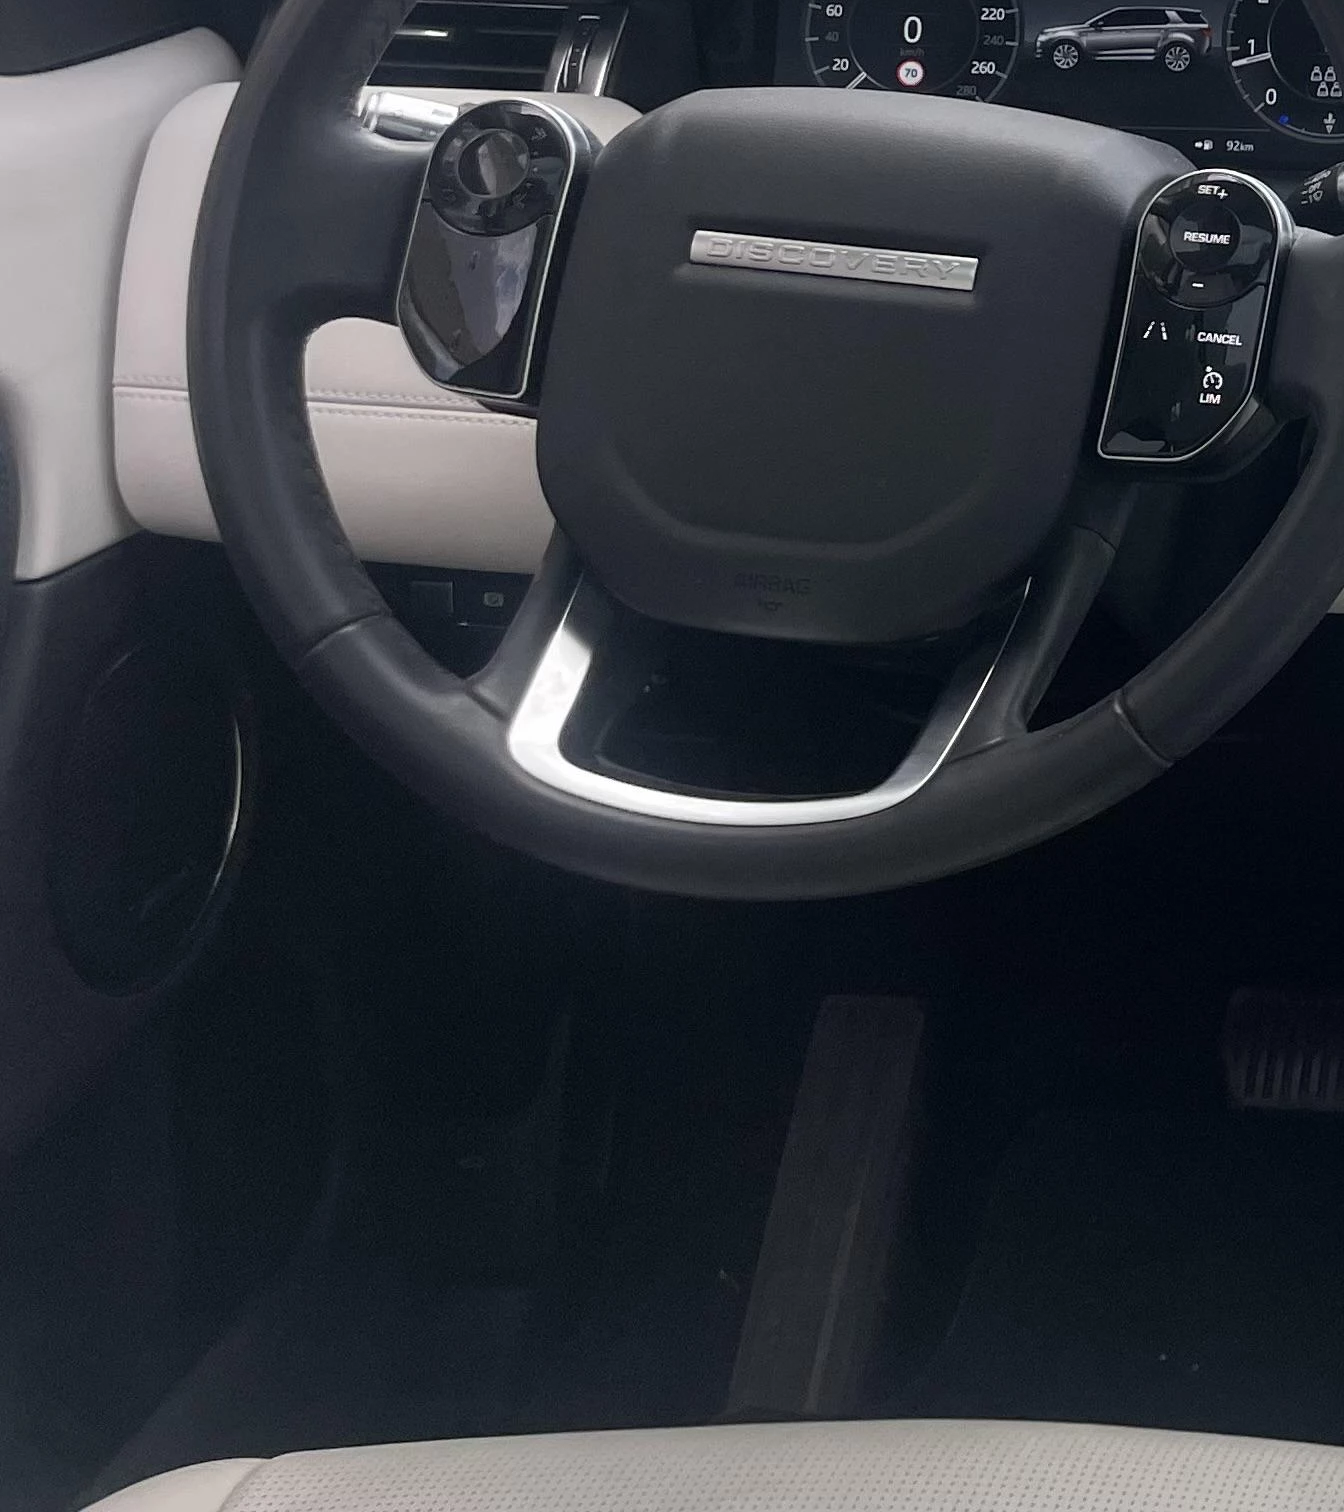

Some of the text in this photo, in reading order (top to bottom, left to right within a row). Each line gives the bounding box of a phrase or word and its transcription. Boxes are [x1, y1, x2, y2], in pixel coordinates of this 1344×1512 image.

[826, 4, 843, 17] 60
[980, 8, 1005, 21] 220
[903, 15, 923, 44] 0
[1247, 40, 1256, 54] 1
[832, 58, 849, 71] 20
[971, 61, 996, 75] 260
[904, 68, 918, 78] 70
[1265, 88, 1277, 105] 0
[1184, 231, 1230, 245] RESUME
[706, 238, 962, 281] DISCOVERY
[1197, 331, 1242, 346] CANCEL
[1200, 393, 1221, 405] LIM
